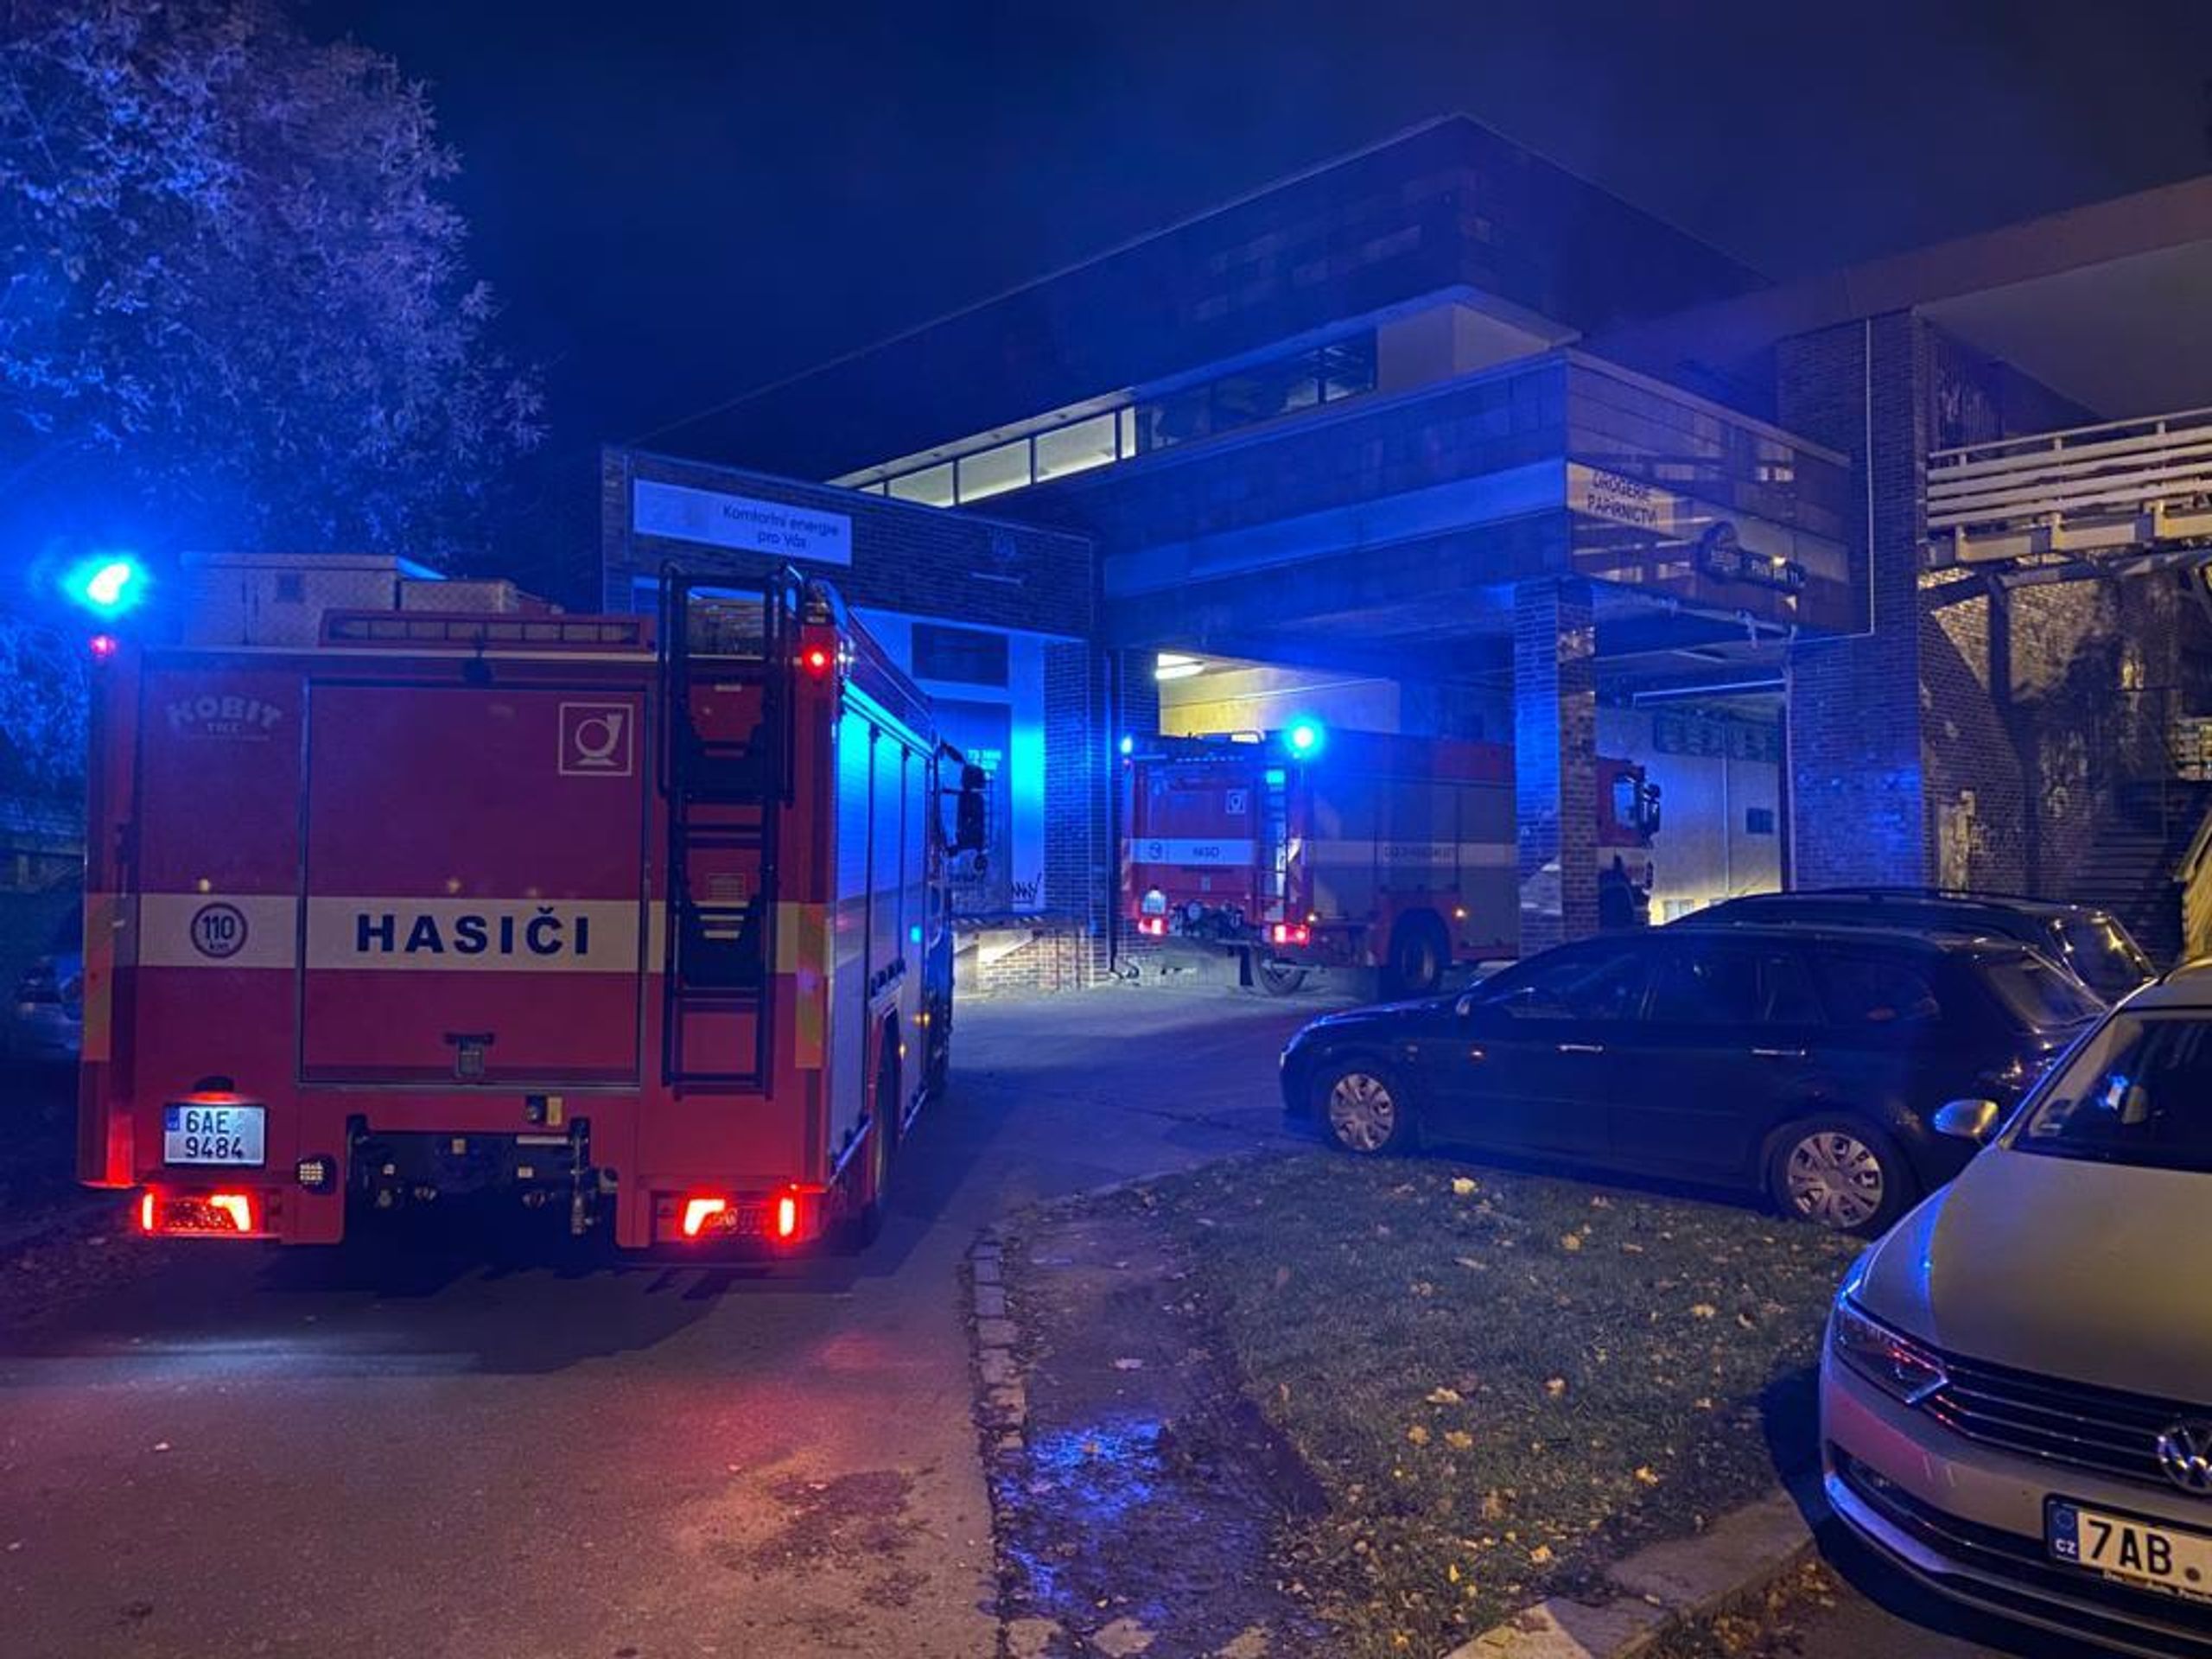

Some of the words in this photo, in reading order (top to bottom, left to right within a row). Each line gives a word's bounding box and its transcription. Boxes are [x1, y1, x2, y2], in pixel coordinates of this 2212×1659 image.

[757, 531, 781, 544] pro
[201, 915, 235, 940] 110
[356, 906, 589, 956] HASIČI
[186, 1110, 231, 1135] 6AE
[185, 1136, 244, 1159] 9484
[2056, 1539, 2077, 1555] CZ
[2088, 1519, 2173, 1576] 7AB
